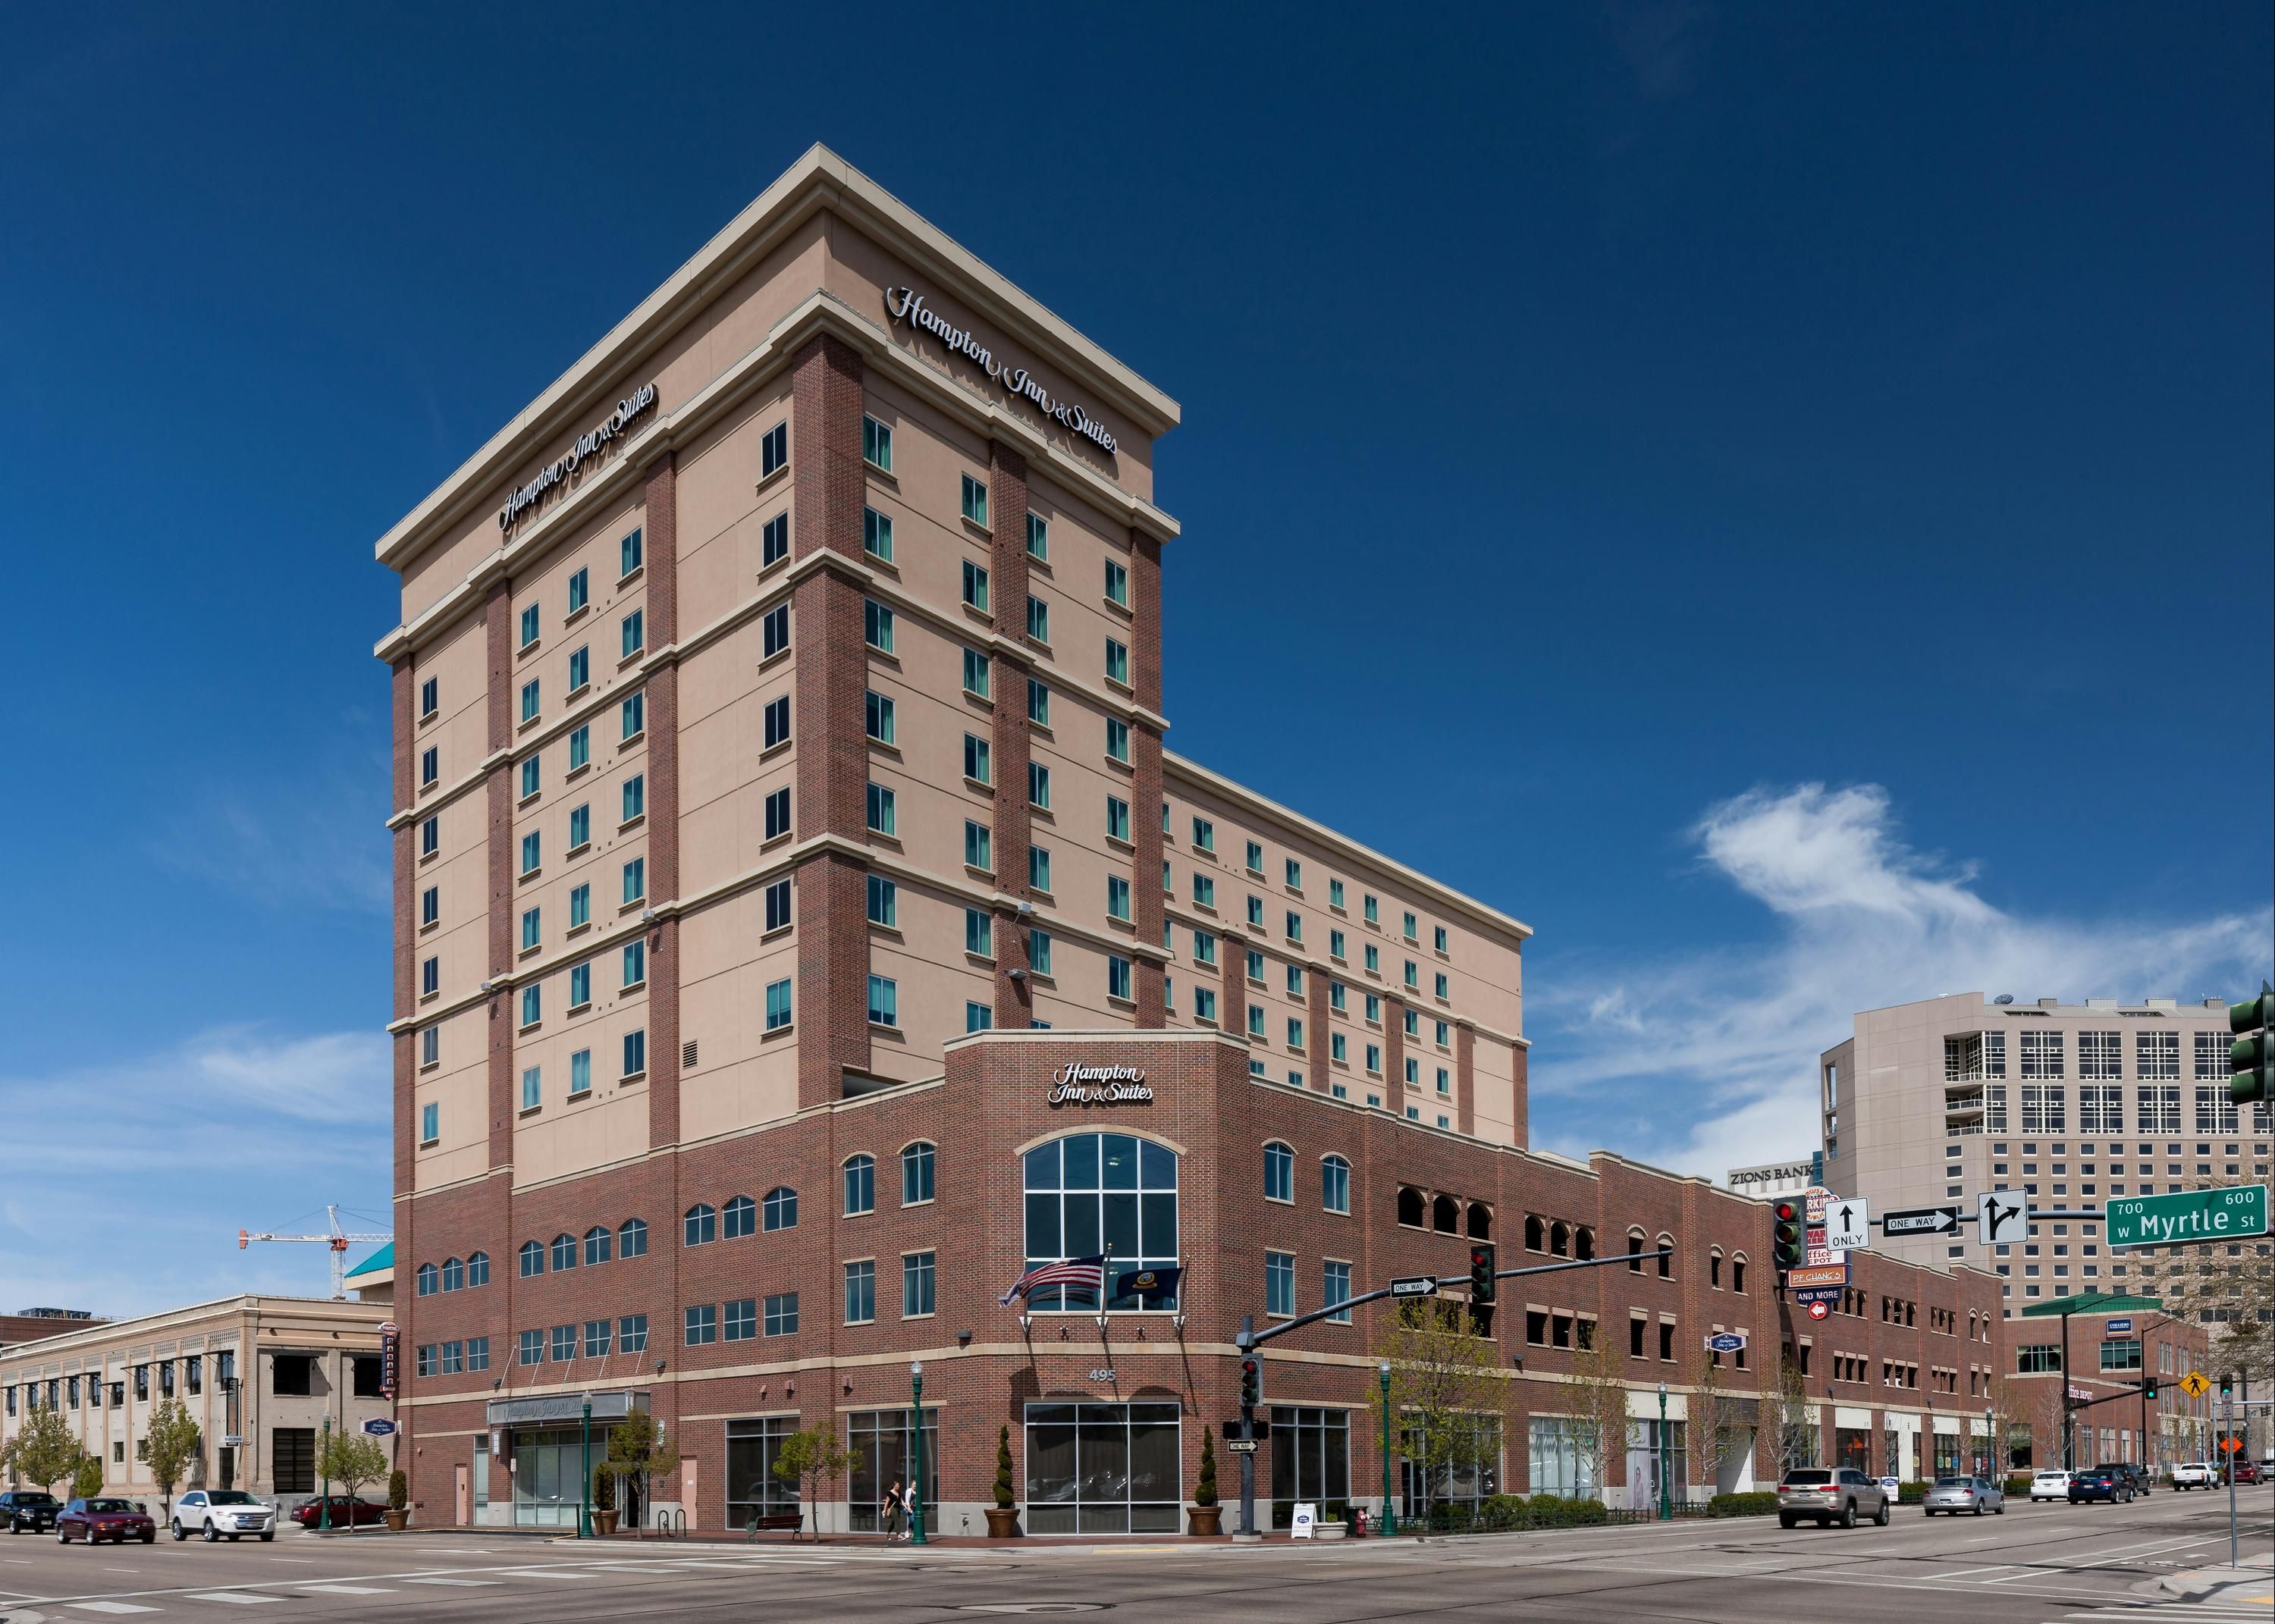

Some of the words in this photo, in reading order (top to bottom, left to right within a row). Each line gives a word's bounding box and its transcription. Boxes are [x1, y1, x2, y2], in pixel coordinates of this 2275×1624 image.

[886, 287, 1001, 376] Hampton
[1003, 367, 1055, 413] Inn
[1056, 403, 1068, 426] &
[1066, 405, 1118, 455] Suites
[497, 460, 564, 531] Hampton
[566, 428, 602, 472] Inn
[603, 421, 612, 440] &
[611, 383, 655, 431] Suites
[1053, 1062, 1144, 1084] Hampton
[1047, 1084, 1094, 1102] Inn
[1094, 1089, 1106, 1102] &
[1104, 1083, 1153, 1101] Suites
[1731, 1170, 1771, 1185] ZIONS
[1774, 1165, 1813, 1180] BANK
[1805, 1188, 1825, 1196] BOISE
[2226, 1192, 2255, 1205] 600
[2117, 1202, 2143, 1215] 700
[1891, 1219, 1909, 1228] ONE
[1916, 1217, 1935, 1226] WAY
[2117, 1227, 2129, 1238] W
[2141, 1209, 2229, 1240] Myrtle
[2241, 1216, 2255, 1227] St
[1833, 1234, 1862, 1246] ONLY
[1806, 1271, 1841, 1281] CHANG'S
[1798, 1292, 1813, 1300] AND
[1816, 1290, 1838, 1300] MORE
[1089, 1369, 1116, 1381] 495
[2069, 1384, 2079, 1398] ffice
[504, 1401, 537, 1421] Hampton
[538, 1400, 560, 1417] Inn
[565, 1398, 583, 1414] Suit
